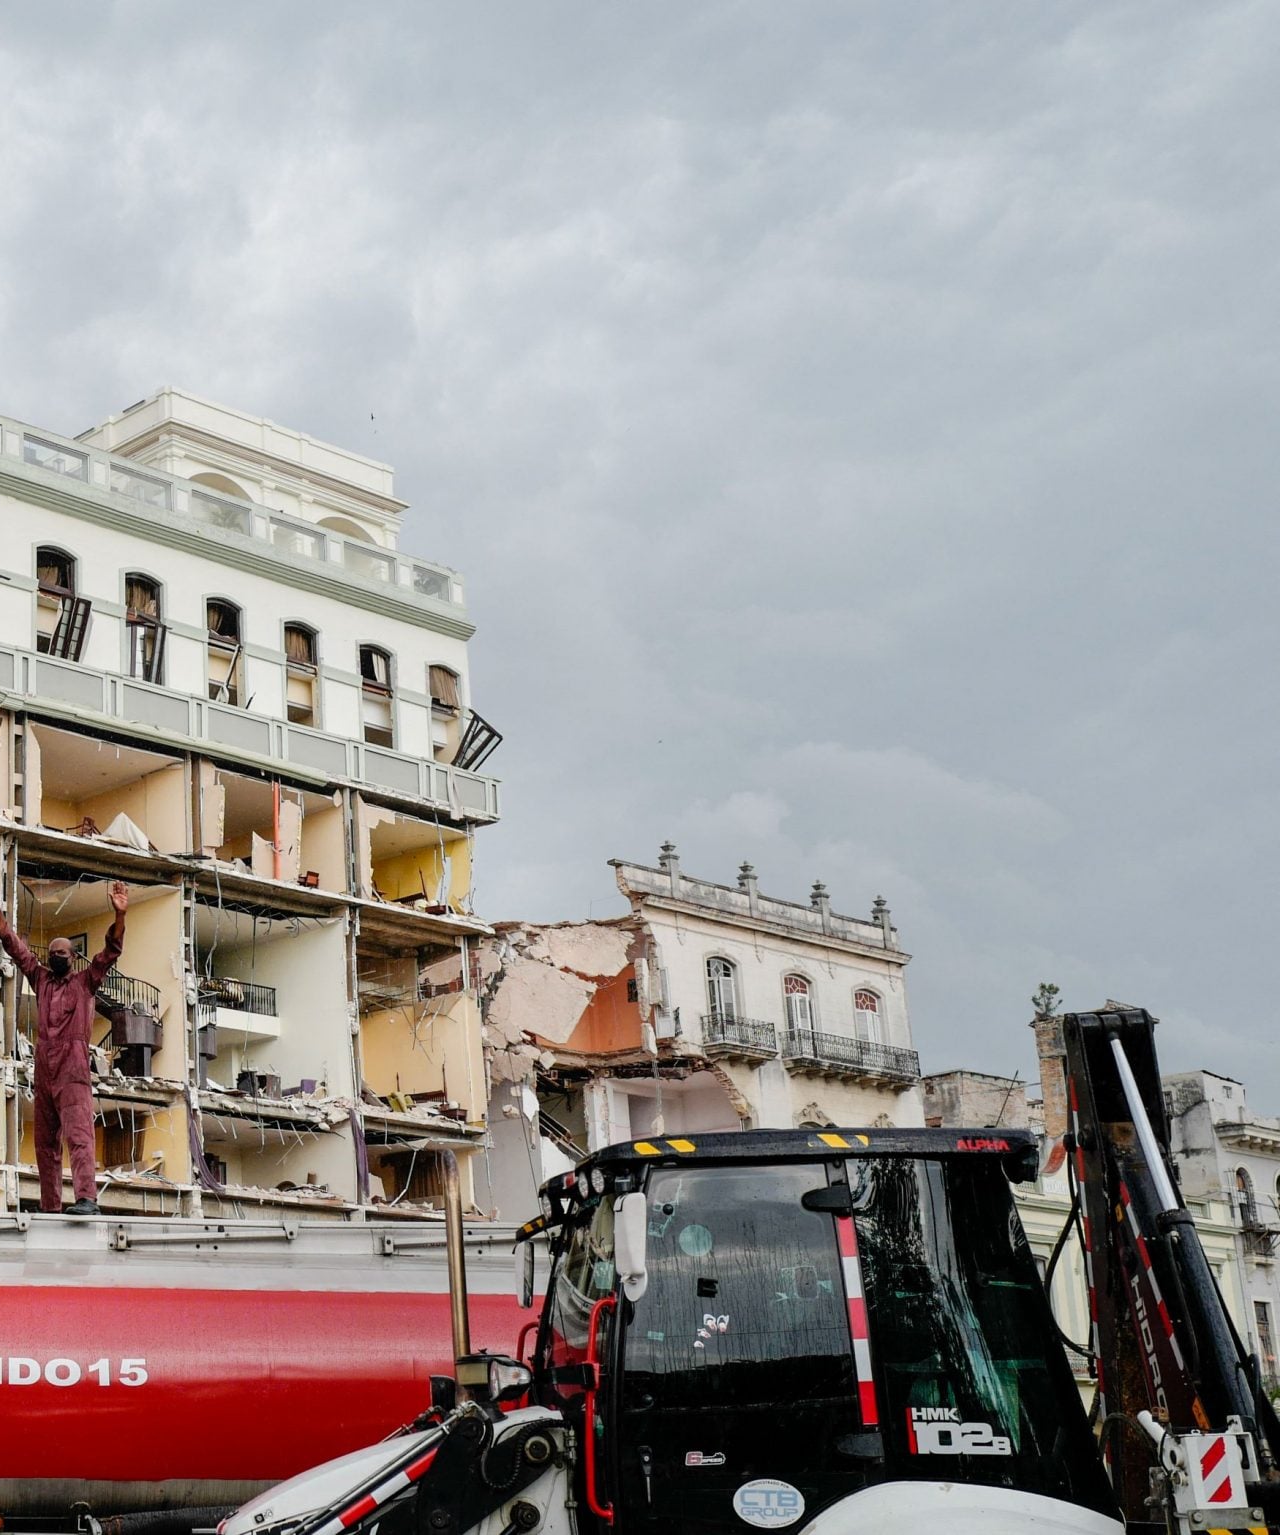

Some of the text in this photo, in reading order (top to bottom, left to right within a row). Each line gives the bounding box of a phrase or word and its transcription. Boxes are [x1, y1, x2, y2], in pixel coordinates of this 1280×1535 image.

[956, 1138, 1011, 1151] ALPHA
[911, 1407, 960, 1421] HMK
[740, 1489, 798, 1507] CTB
[741, 1507, 799, 1519] GROUP
